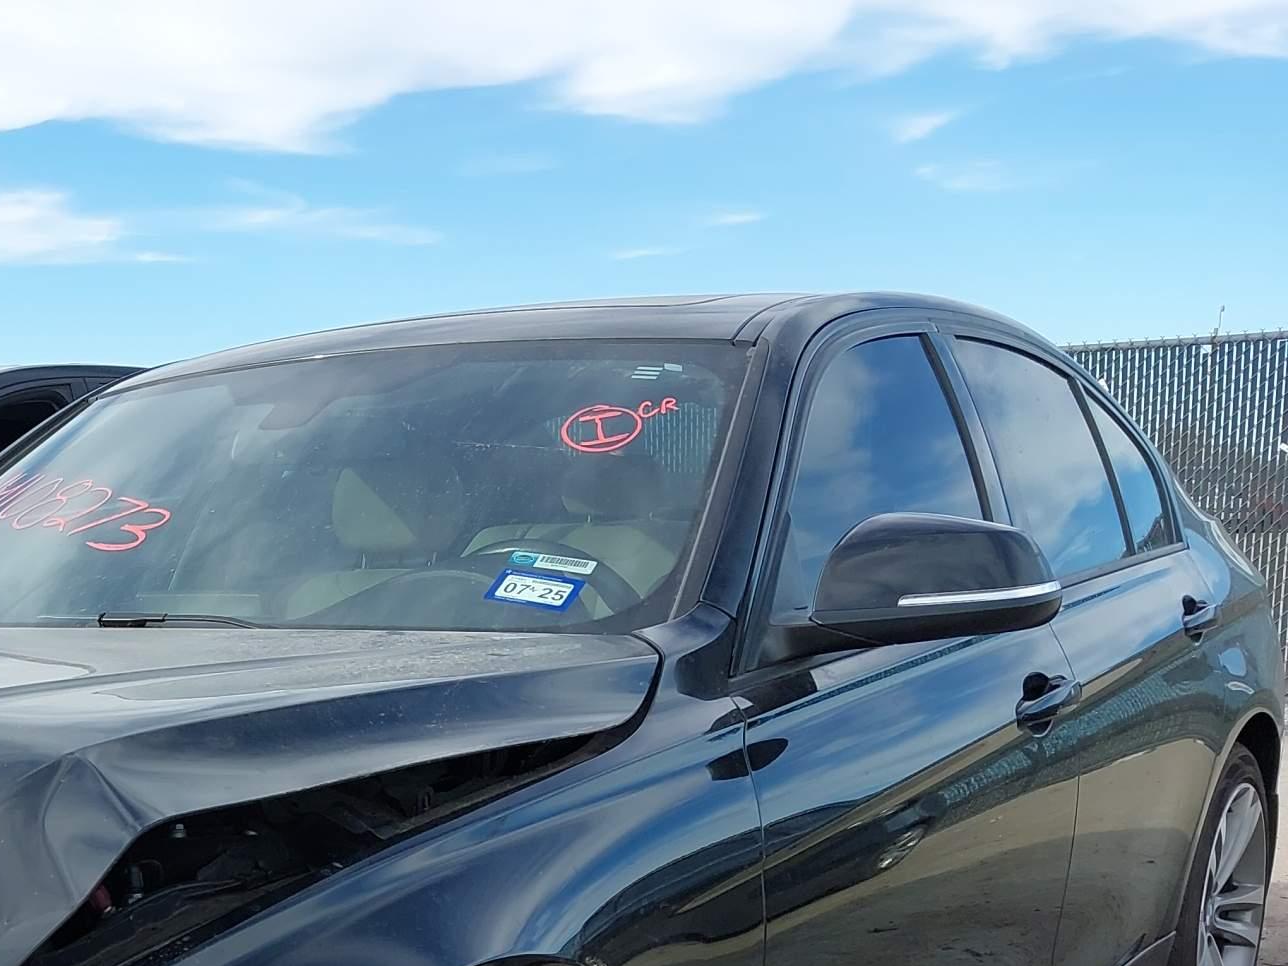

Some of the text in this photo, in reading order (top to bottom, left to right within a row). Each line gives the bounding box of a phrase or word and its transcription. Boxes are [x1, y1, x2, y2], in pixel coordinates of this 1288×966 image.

[638, 397, 680, 418] CR
[503, 582, 531, 595] 07
[537, 587, 567, 602] 25
